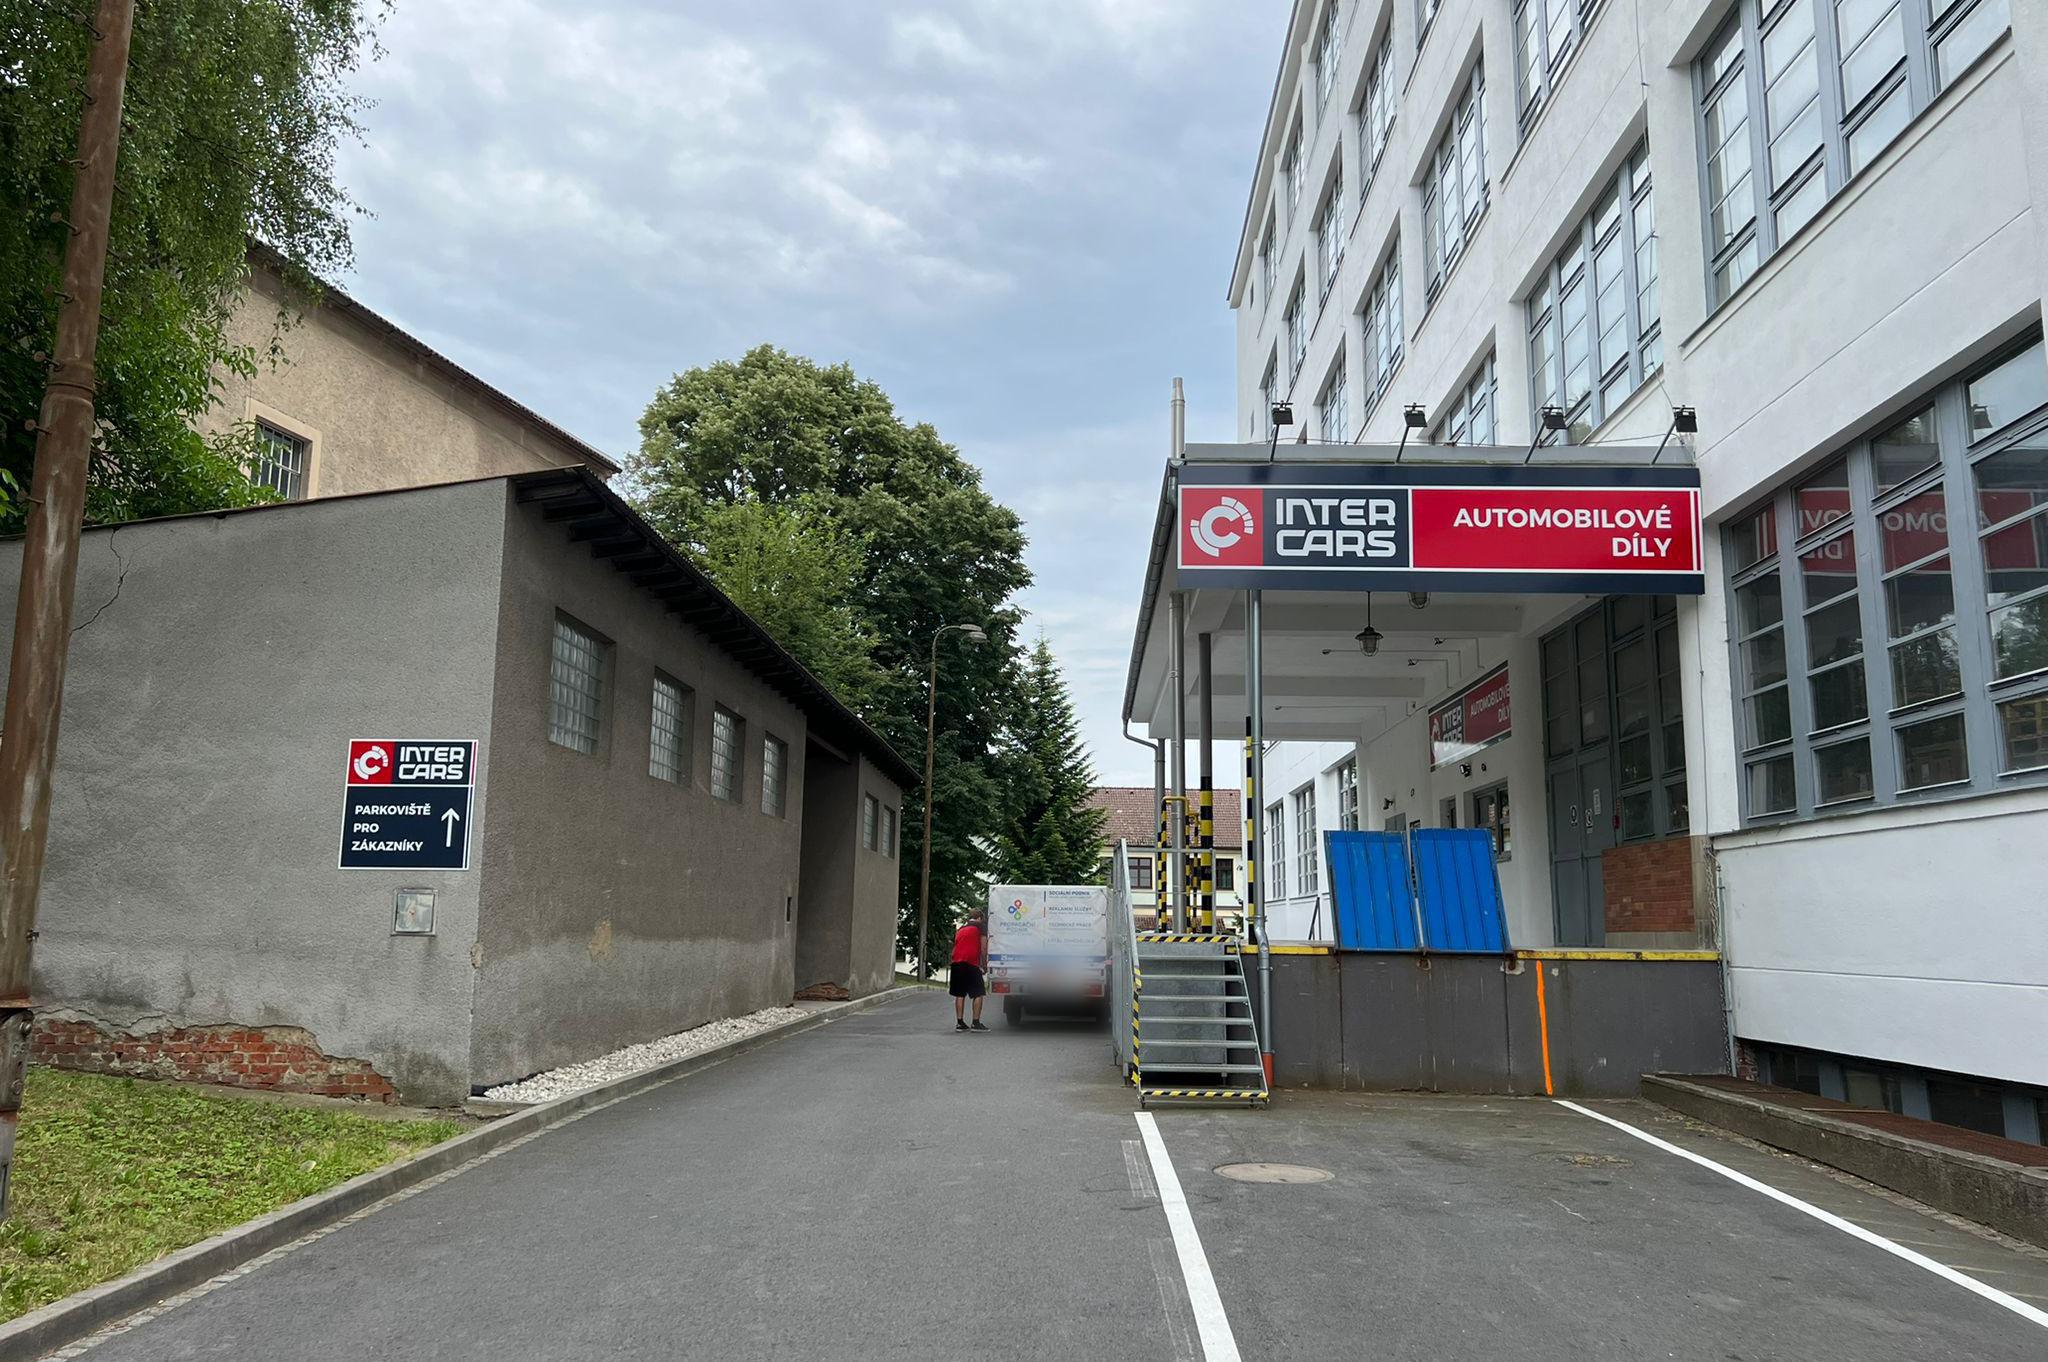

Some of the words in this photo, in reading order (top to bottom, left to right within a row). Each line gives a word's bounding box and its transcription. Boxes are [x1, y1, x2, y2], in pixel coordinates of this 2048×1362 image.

[1276, 498, 1396, 526] INTER
[1453, 504, 1672, 529] AUTOMOBILOVÉ
[1276, 530, 1396, 557] CARS
[1612, 536, 1672, 557] DÍLY
[400, 746, 465, 762] INTER
[398, 764, 464, 780] CARS
[354, 803, 431, 816] PARKOVIŠTĚ
[353, 823, 379, 833] PRO
[351, 839, 424, 852] ZÁKAZNÍKY
